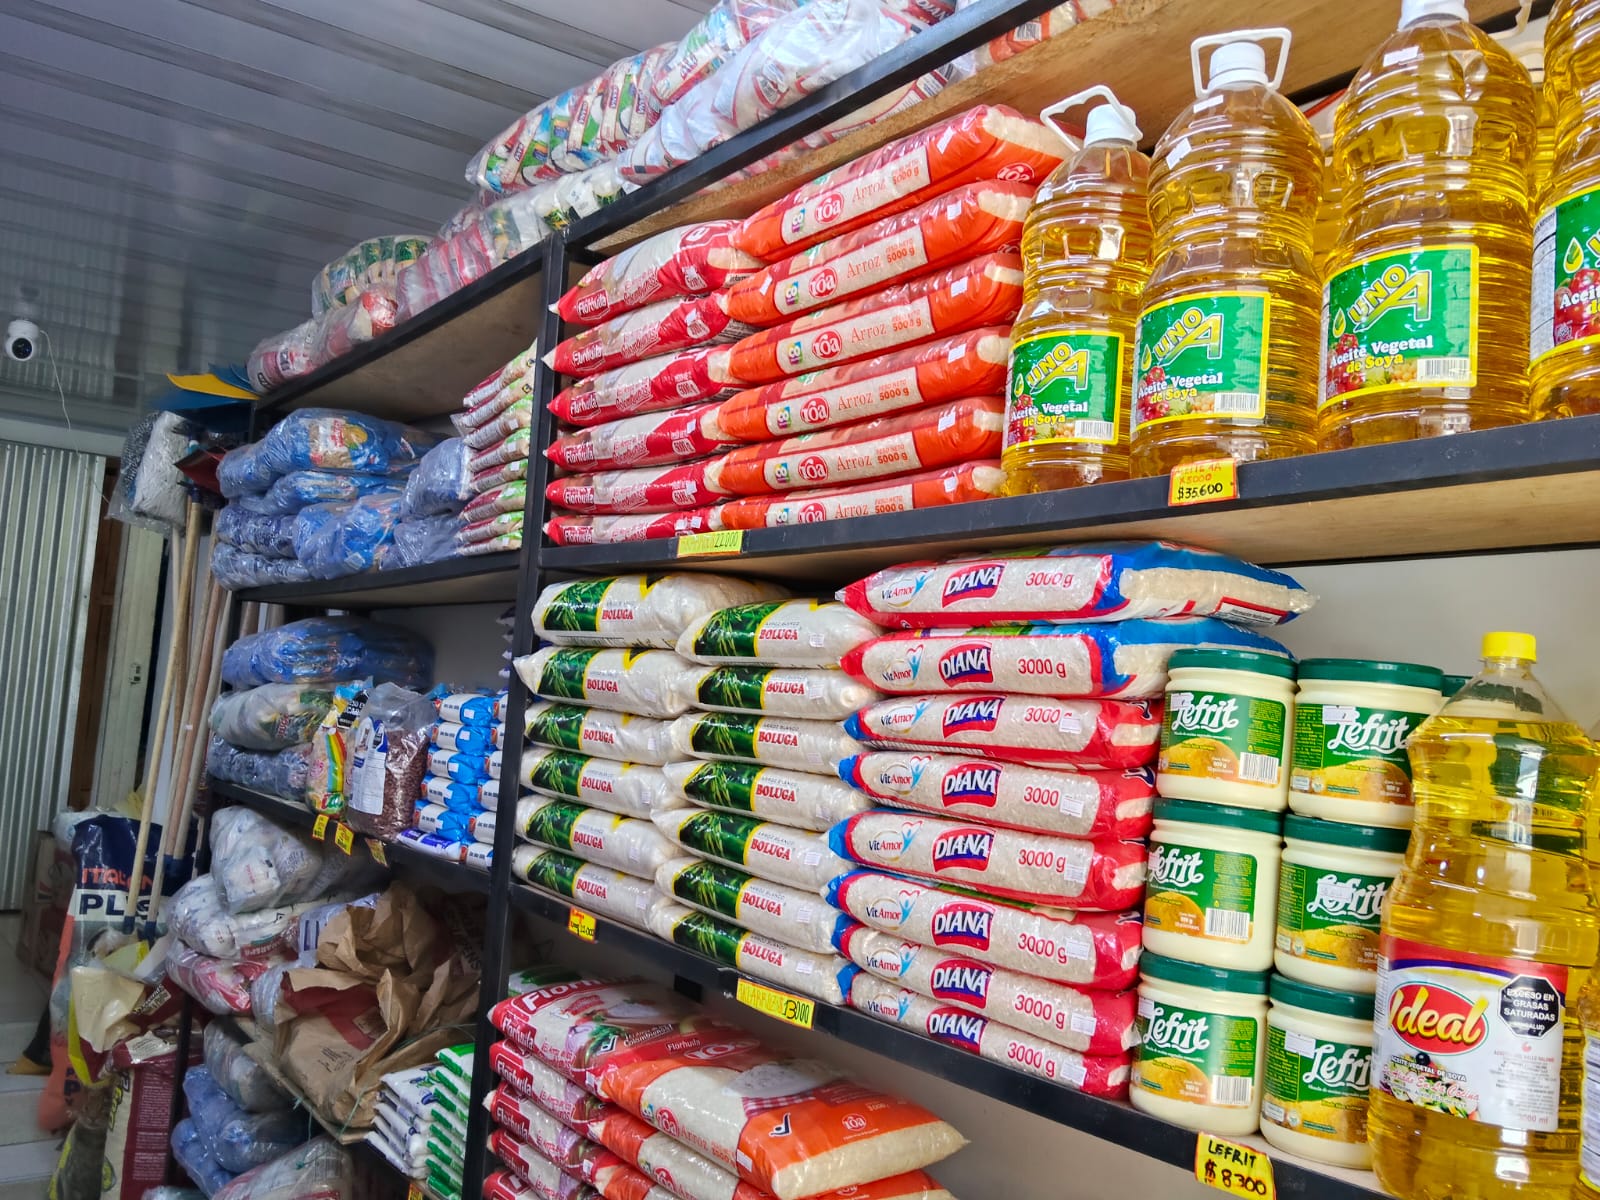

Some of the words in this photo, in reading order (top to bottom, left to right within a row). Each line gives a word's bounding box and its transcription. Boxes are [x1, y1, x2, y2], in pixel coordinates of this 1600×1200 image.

[847, 255, 881, 279] Arroz
[1348, 264, 1409, 323] UNO
[851, 323, 887, 343] Arroz
[1154, 307, 1203, 358] UNO
[1330, 347, 1366, 368] Aceite
[1371, 335, 1433, 354] Vegetal
[1026, 342, 1072, 387] UNO
[1346, 361, 1361, 374] de
[1365, 353, 1404, 369] Soya
[1137, 380, 1167, 399] Aceite
[1169, 372, 1223, 388] Vegetal
[1150, 392, 1163, 403] de
[1165, 388, 1198, 401] Soya
[838, 393, 873, 411] Arroz
[879, 387, 901, 401] 5000
[1011, 405, 1038, 421] Aceite
[1042, 401, 1088, 415] Vegetal
[1023, 416, 1035, 426] de
[1037, 414, 1066, 426] Soya
[837, 454, 872, 471] Arroz
[878, 452, 899, 464] 5000
[834, 502, 869, 518] Arroz
[946, 564, 1002, 596] DIANA
[1063, 574, 1074, 589] g
[882, 583, 915, 600] VitAmor
[602, 609, 634, 620] BOLUGA
[759, 628, 798, 640] BOLUGA
[883, 667, 912, 682] VitAmor
[940, 649, 992, 680] DIANA
[1018, 658, 1052, 675] 3000
[1056, 662, 1066, 679] g
[587, 679, 618, 693] BOLUGA
[766, 680, 805, 694] BOLUGA
[881, 711, 915, 726] VitAmor
[945, 699, 1001, 724] DIANA
[1025, 708, 1060, 723] 3000
[583, 729, 615, 744] BOLUGA
[759, 731, 798, 746] BOLUGA
[582, 776, 613, 793] BOLUGA
[880, 772, 912, 786] VitAmor
[945, 766, 999, 795] DIANA
[756, 784, 796, 802] BOLUGA
[1024, 786, 1059, 806] 3000
[574, 831, 603, 850] BOLUGA
[751, 839, 791, 861] BOLUGA
[869, 839, 903, 852] VitAmor
[935, 832, 991, 861] DIANA
[1018, 849, 1053, 867] 3000
[1056, 855, 1066, 872] g
[576, 878, 607, 899] BOLUGA
[79, 894, 158, 920] PLS
[742, 892, 782, 916] BOLUGA
[866, 907, 900, 921] VitAmor
[934, 911, 990, 938] DIANA
[742, 941, 782, 967] BOLUGA
[1018, 933, 1054, 955] 3000
[1057, 945, 1067, 964] g
[866, 957, 900, 973] VitAmor
[932, 968, 989, 997] DIANA
[1506, 988, 1542, 1001] EXCESO
[1543, 993, 1555, 1002] EN
[1513, 1000, 1549, 1011] GRASAS
[868, 1001, 898, 1017] VitAmor
[1015, 995, 1052, 1019] 3000
[1056, 1011, 1065, 1029] g
[1389, 986, 1489, 1045] Ideal
[1503, 1007, 1556, 1021] SATURADAS
[929, 1014, 984, 1042] DIANA
[1143, 1007, 1210, 1054] Lefrit
[1007, 1042, 1042, 1068] 3000
[1045, 1060, 1055, 1077] g
[1303, 1044, 1372, 1091] Lefri
[1409, 1062, 1435, 1075] VEGETAL
[1437, 1069, 1446, 1077] DE
[1446, 1072, 1467, 1081] SOYA
[1208, 1140, 1256, 1168] LEFRIT
[1221, 1169, 1267, 1196] 8300
